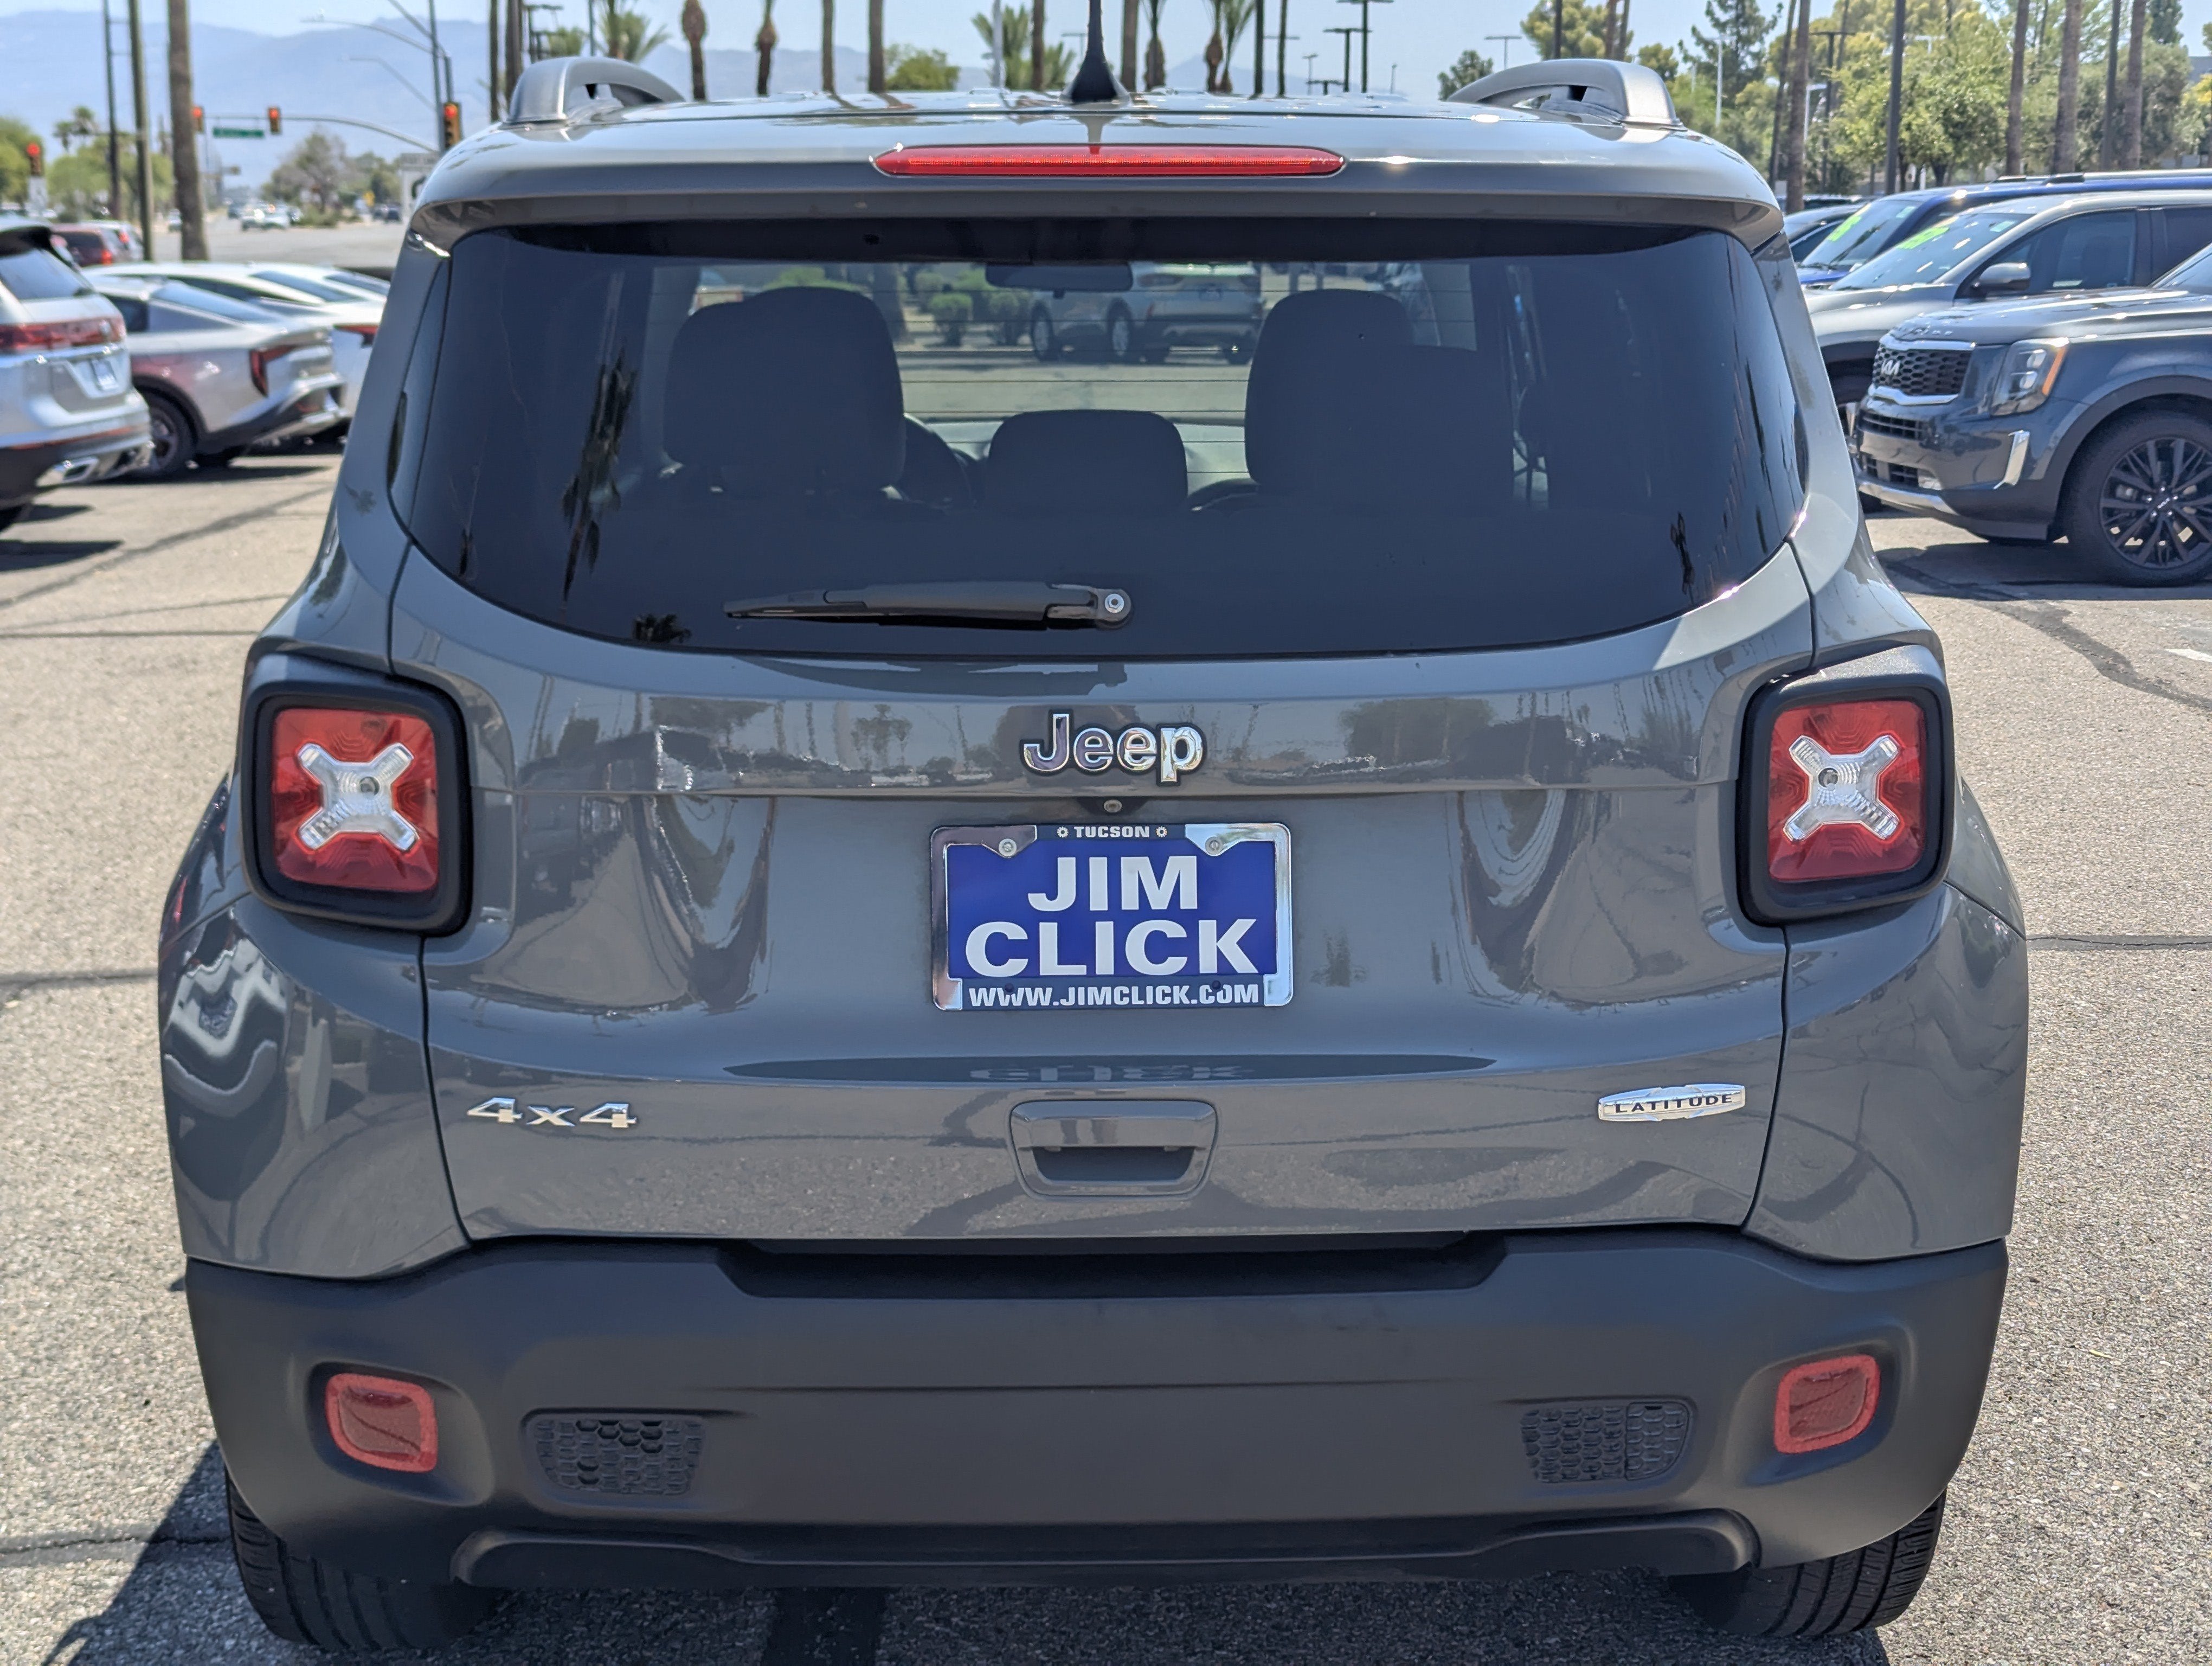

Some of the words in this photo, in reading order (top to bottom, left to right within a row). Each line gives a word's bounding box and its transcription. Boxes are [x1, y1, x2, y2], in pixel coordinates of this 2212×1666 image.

[1023, 714, 1203, 783] Jeep
[1074, 826, 1149, 838] TUCSON
[1028, 856, 1198, 911] JIM
[966, 919, 1259, 977] CLICK
[969, 984, 1258, 1007] WWW.JIMCLICK.COM
[1616, 1094, 1733, 1113] LATITUDE
